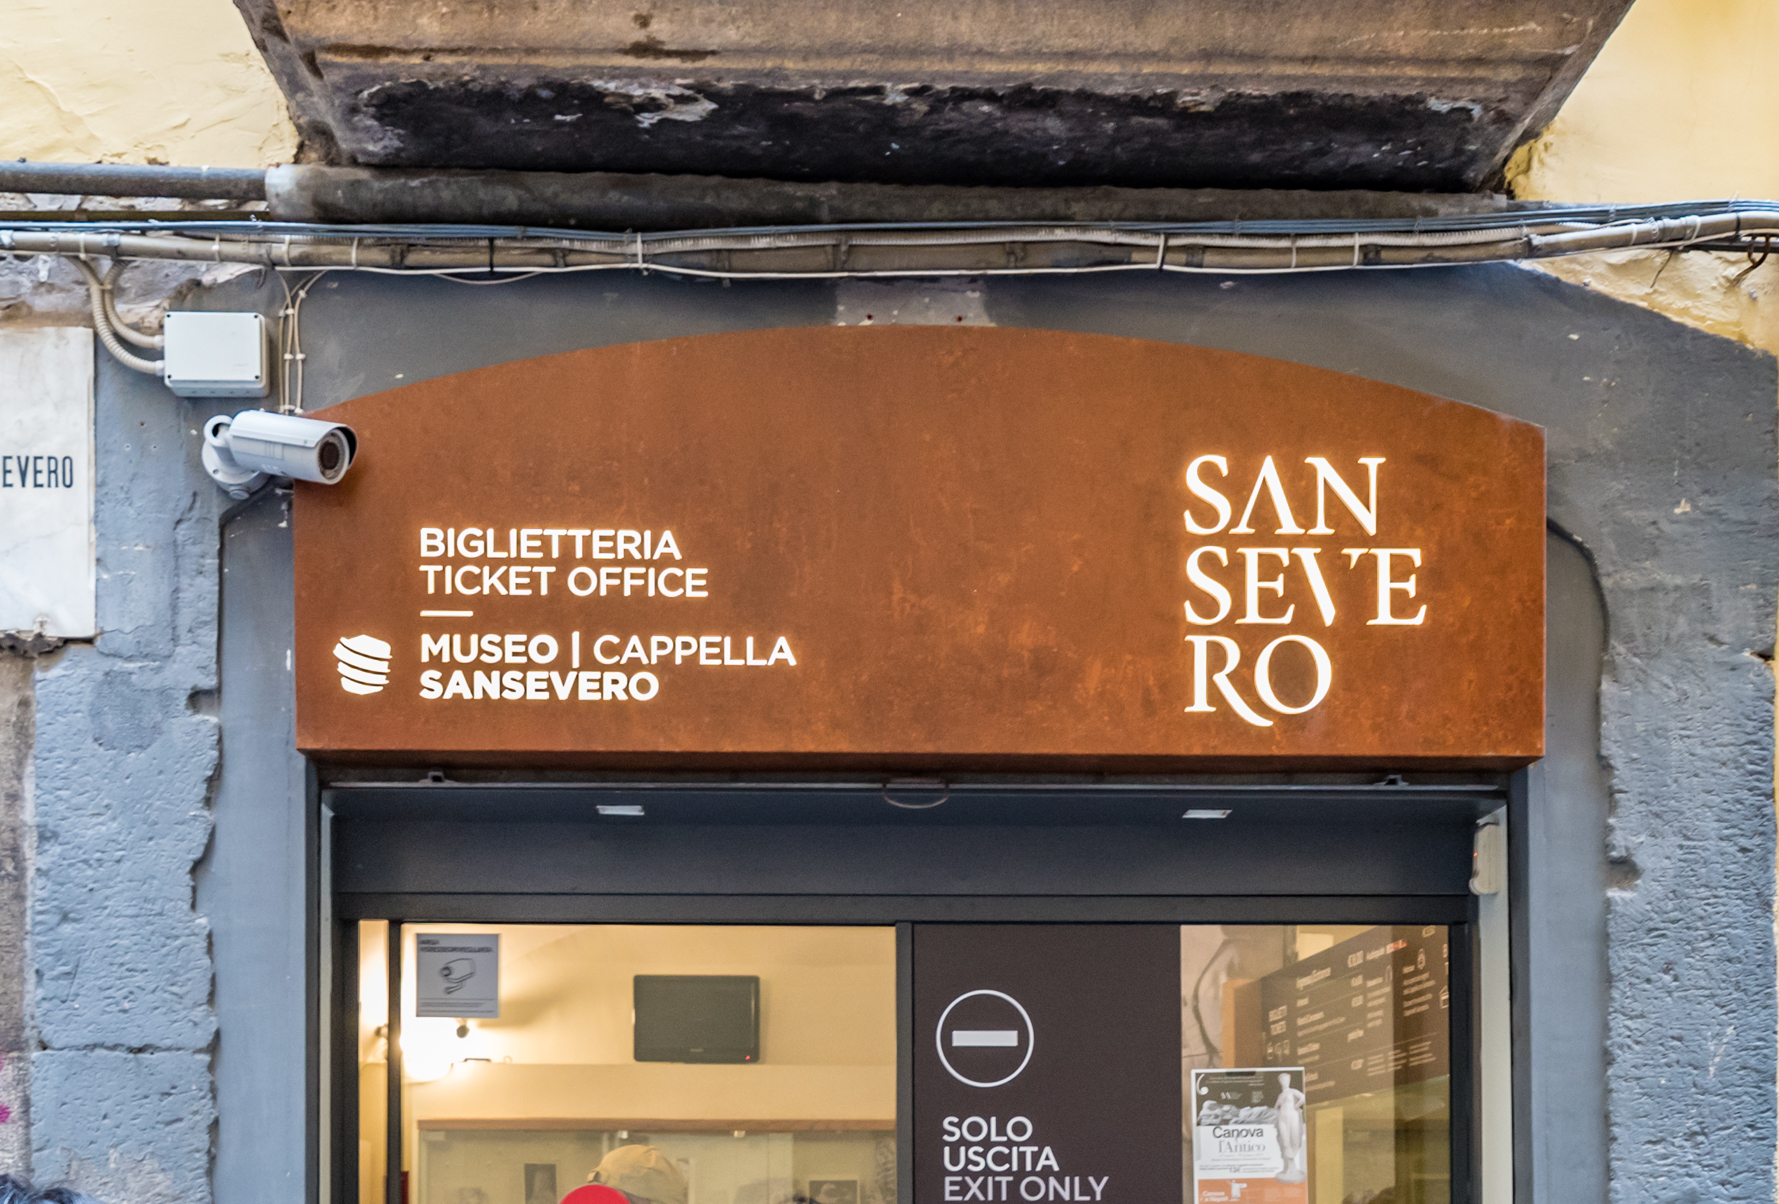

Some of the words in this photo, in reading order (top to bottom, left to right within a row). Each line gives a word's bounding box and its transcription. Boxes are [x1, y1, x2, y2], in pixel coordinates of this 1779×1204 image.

[2, 455, 73, 488] EVERO
[1183, 454, 1386, 536] SAN
[419, 527, 682, 560] BIGLIETTERIA
[419, 565, 556, 596] TICKET
[567, 566, 709, 597] OFFICE
[1183, 545, 1427, 627] SEVE
[420, 633, 559, 664] MUSEO
[593, 635, 797, 666] CAPPELLA
[419, 670, 659, 701] SANSEVERO
[1184, 634, 1332, 727] RO
[942, 1116, 1033, 1142] SOLO
[1212, 1126, 1264, 1139] Canova
[943, 1146, 1060, 1172] USCITA
[944, 1176, 1013, 1201] EXIT
[1019, 1175, 1109, 1201] ONLY
